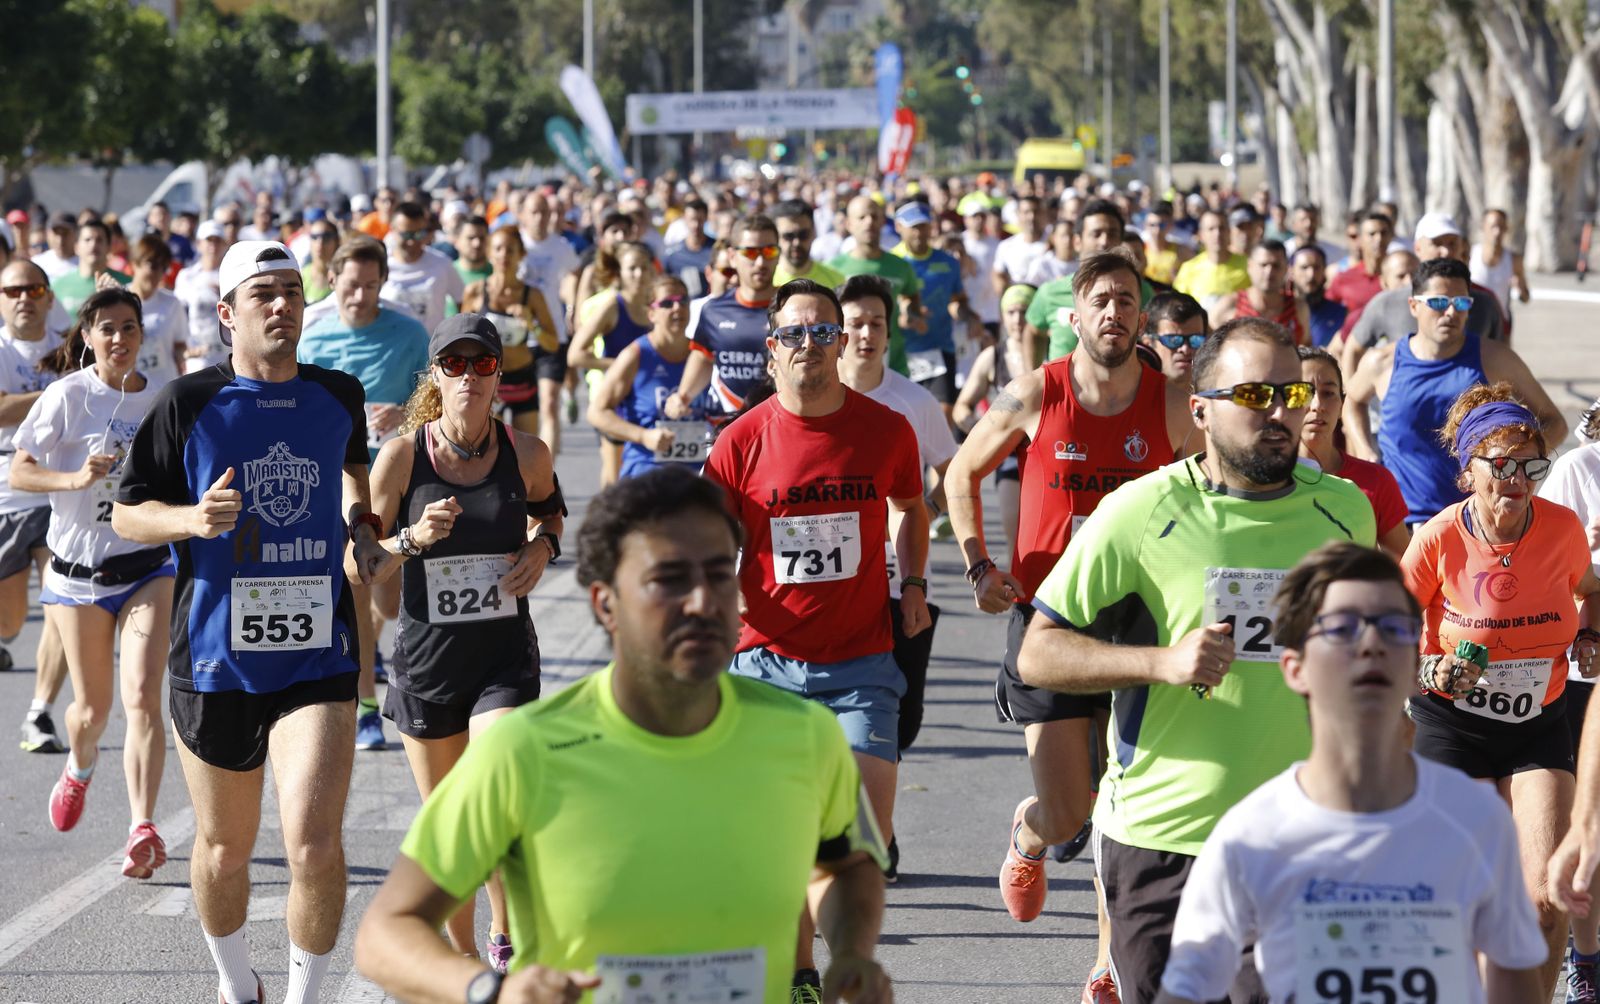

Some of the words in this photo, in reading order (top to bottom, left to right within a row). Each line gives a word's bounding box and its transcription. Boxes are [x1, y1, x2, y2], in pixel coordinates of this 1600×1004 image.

[256, 398, 296, 408] hummel
[243, 460, 320, 493] MARISTAS
[766, 483, 878, 507] J.SARRIA
[437, 558, 467, 567] CARRERA
[781, 547, 843, 577] 731
[244, 580, 277, 588] CARRERA
[1221, 572, 1261, 580] CARRERA
[1263, 572, 1274, 580] DE
[437, 585, 502, 616] 824
[240, 613, 314, 644] 553
[1474, 618, 1511, 630] CIUDAD
[1512, 615, 1526, 628] DE
[1527, 611, 1562, 626] BAENA
[1524, 660, 1548, 668] PRENSA
[1466, 687, 1533, 718] 860
[1315, 966, 1438, 1004] 959
